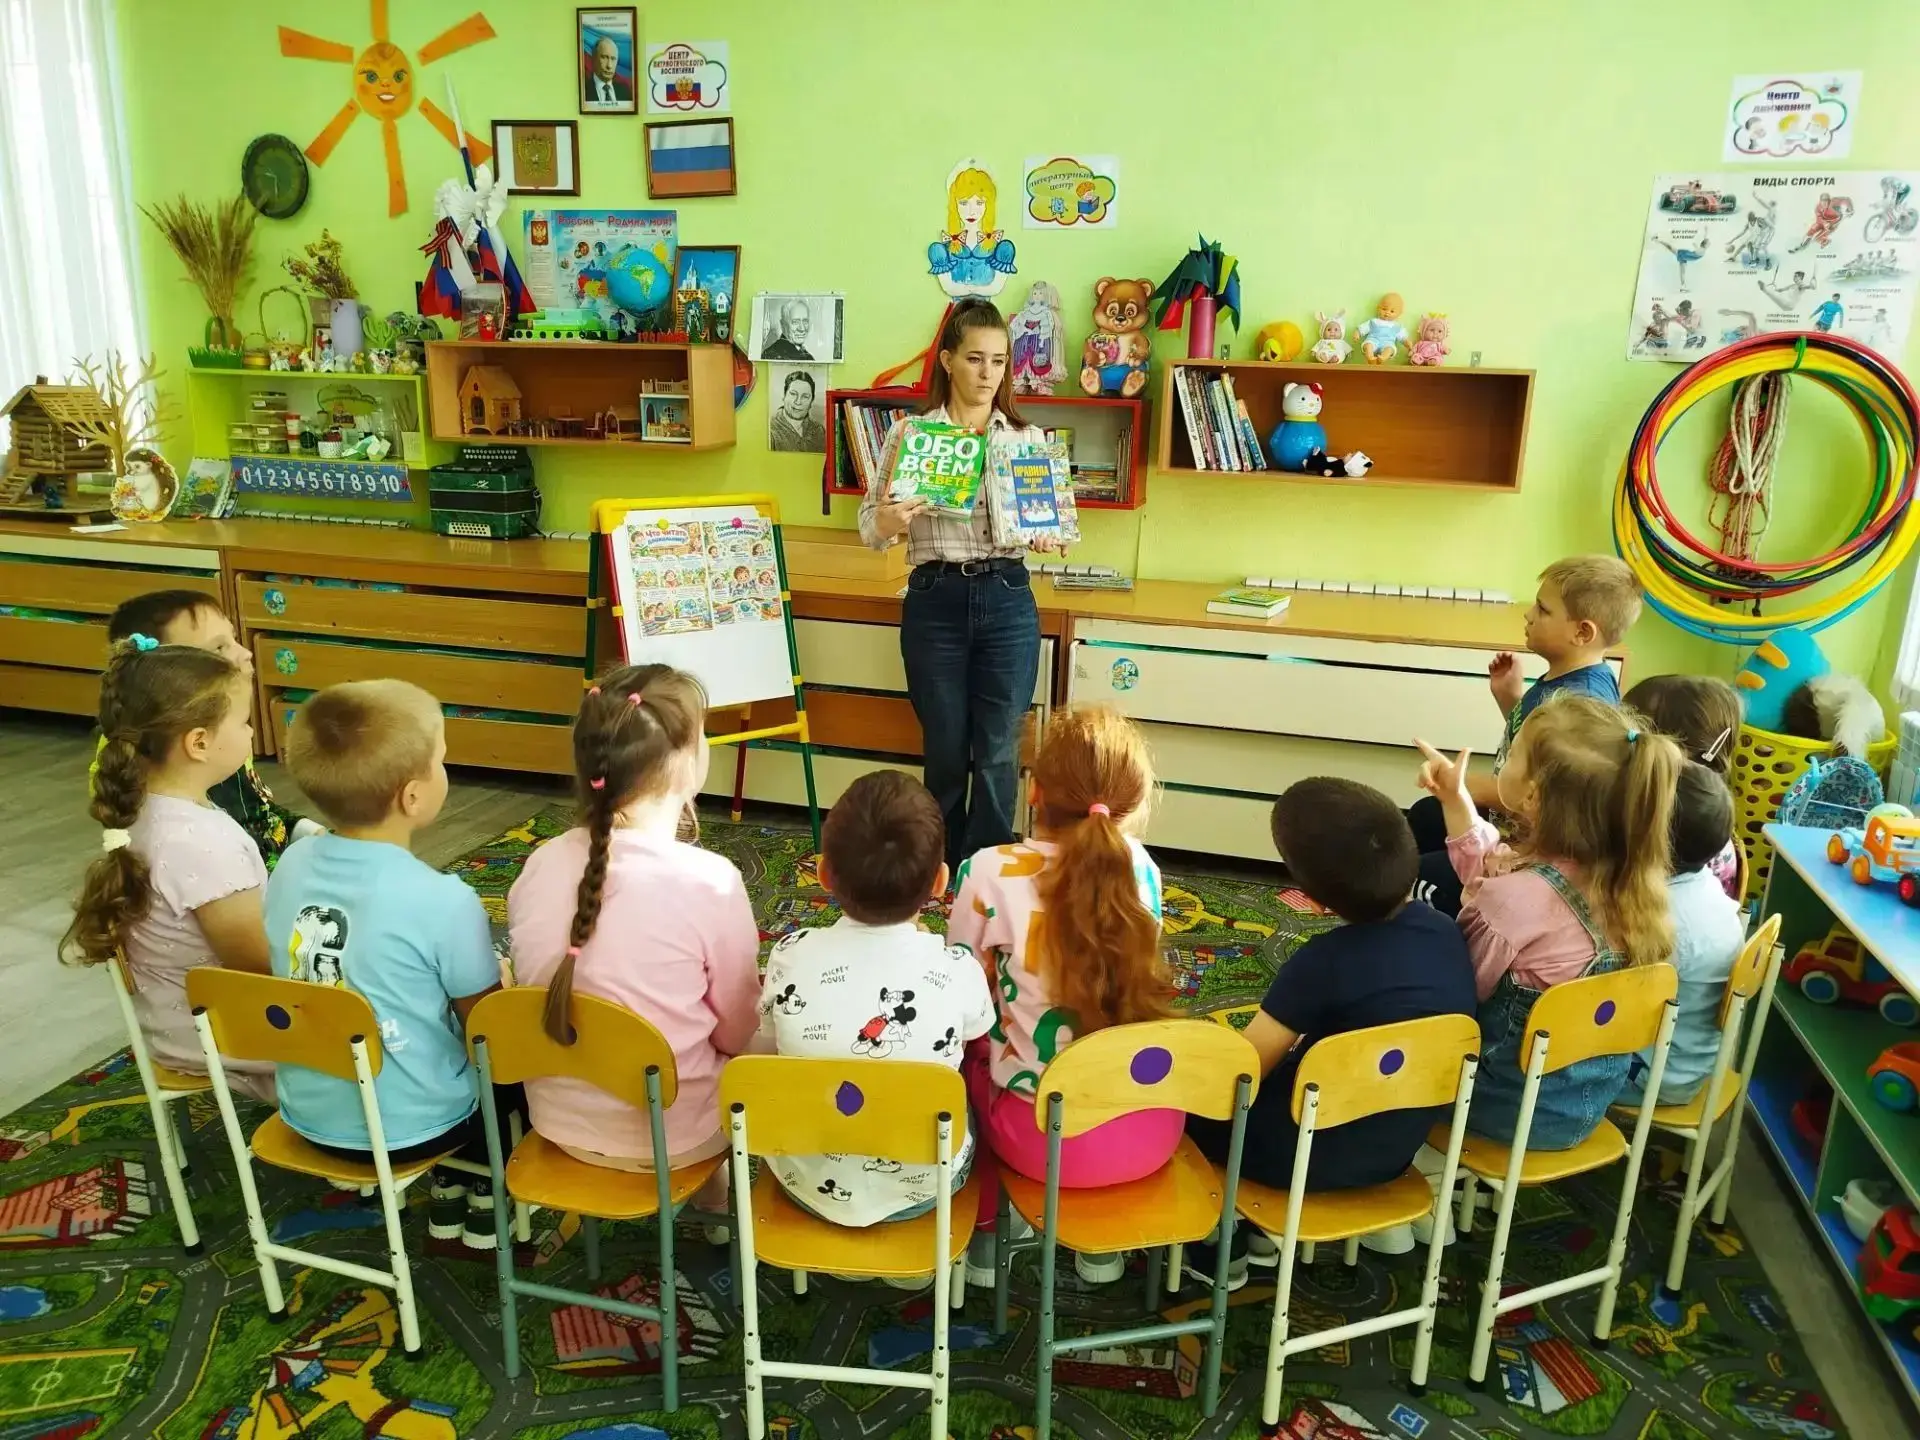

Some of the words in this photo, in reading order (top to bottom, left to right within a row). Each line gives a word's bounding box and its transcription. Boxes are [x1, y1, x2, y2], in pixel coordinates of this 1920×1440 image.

[668, 51, 690, 60] ЦЕНТР
[1766, 91, 1801, 100] Центр
[1753, 178, 1788, 187] ВИДЫ
[1791, 177, 1836, 186] СПОРТА
[906, 432, 981, 460] ОБО
[1013, 465, 1050, 477] ПРАВИЛА
[242, 466, 251, 484] 0
[255, 467, 263, 485] 1
[267, 469, 278, 486] 2
[281, 470, 291, 487] 3
[295, 471, 305, 488] 4
[308, 472, 319, 489] 5
[323, 473, 334, 490] 6
[336, 473, 346, 490] 7
[351, 474, 361, 491] 8
[365, 474, 376, 491] 9
[380, 475, 400, 493] 10
[922, 473, 972, 487] СВЕТЕ
[821, 965, 850, 978] MICKEY
[820, 975, 846, 985] MOUSE
[923, 976, 945, 990] MOUSE
[803, 1023, 832, 1033] MICKEY
[802, 1033, 827, 1041] MOUSE
[823, 1152, 842, 1163] OUSE
[903, 1172, 931, 1181] MICKEY
